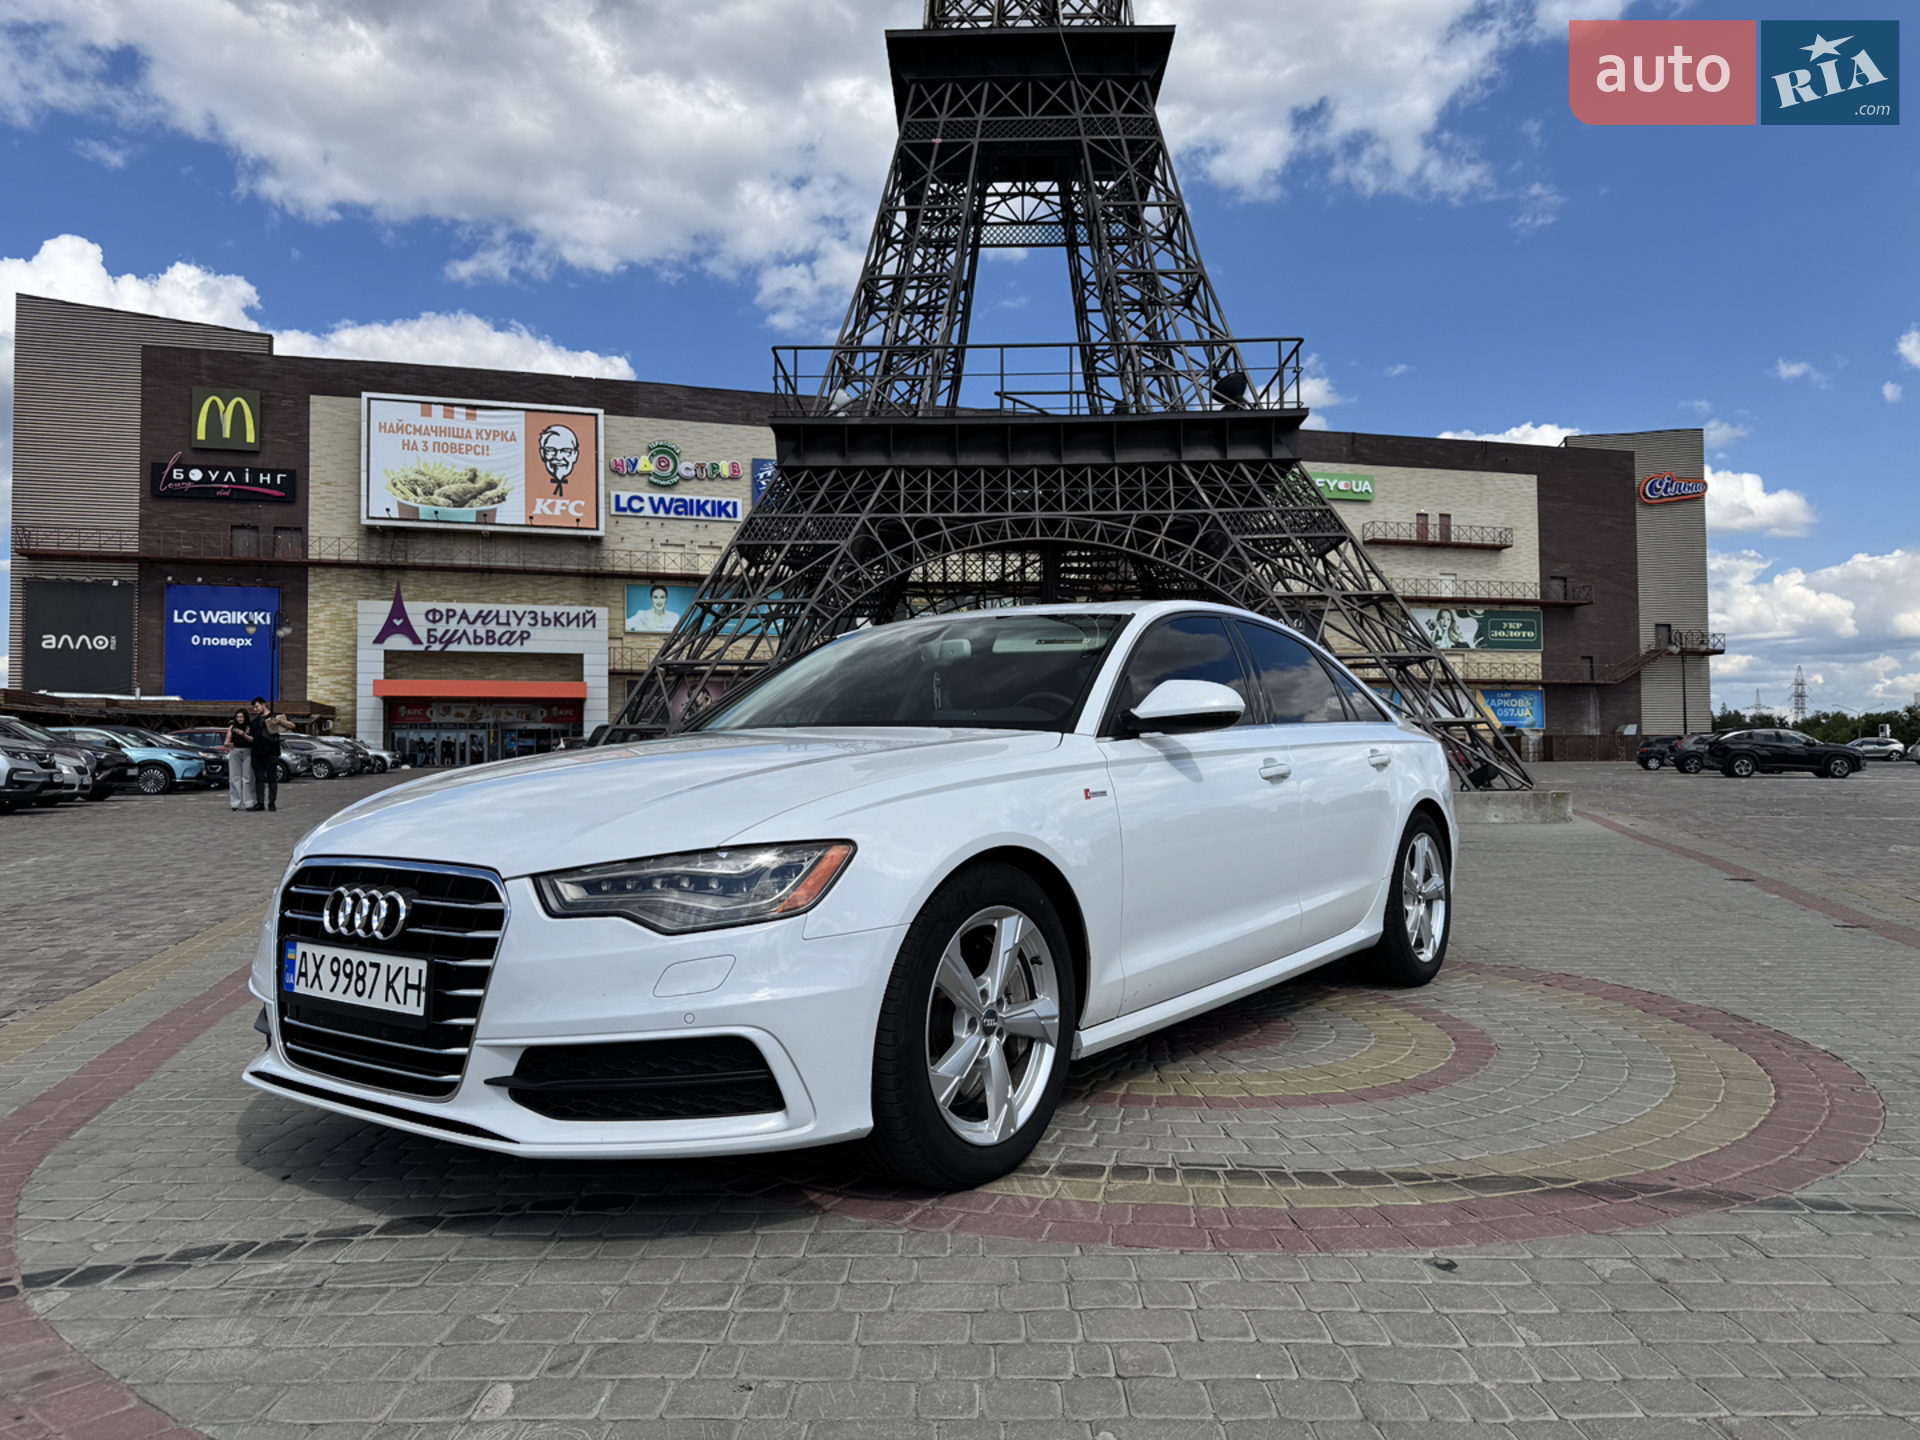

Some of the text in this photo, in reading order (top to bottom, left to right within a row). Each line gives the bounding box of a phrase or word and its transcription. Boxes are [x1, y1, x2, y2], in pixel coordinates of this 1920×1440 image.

[378, 418, 518, 443] НАЙСМАЧНІША КУРКА
[402, 439, 491, 456] НА 3 ПОВЕРСІ!
[533, 498, 586, 516] KFC
[615, 494, 645, 513] LC
[173, 610, 197, 624] LC
[202, 637, 253, 648] поверх
[296, 951, 423, 1007] AX 9987 KH
